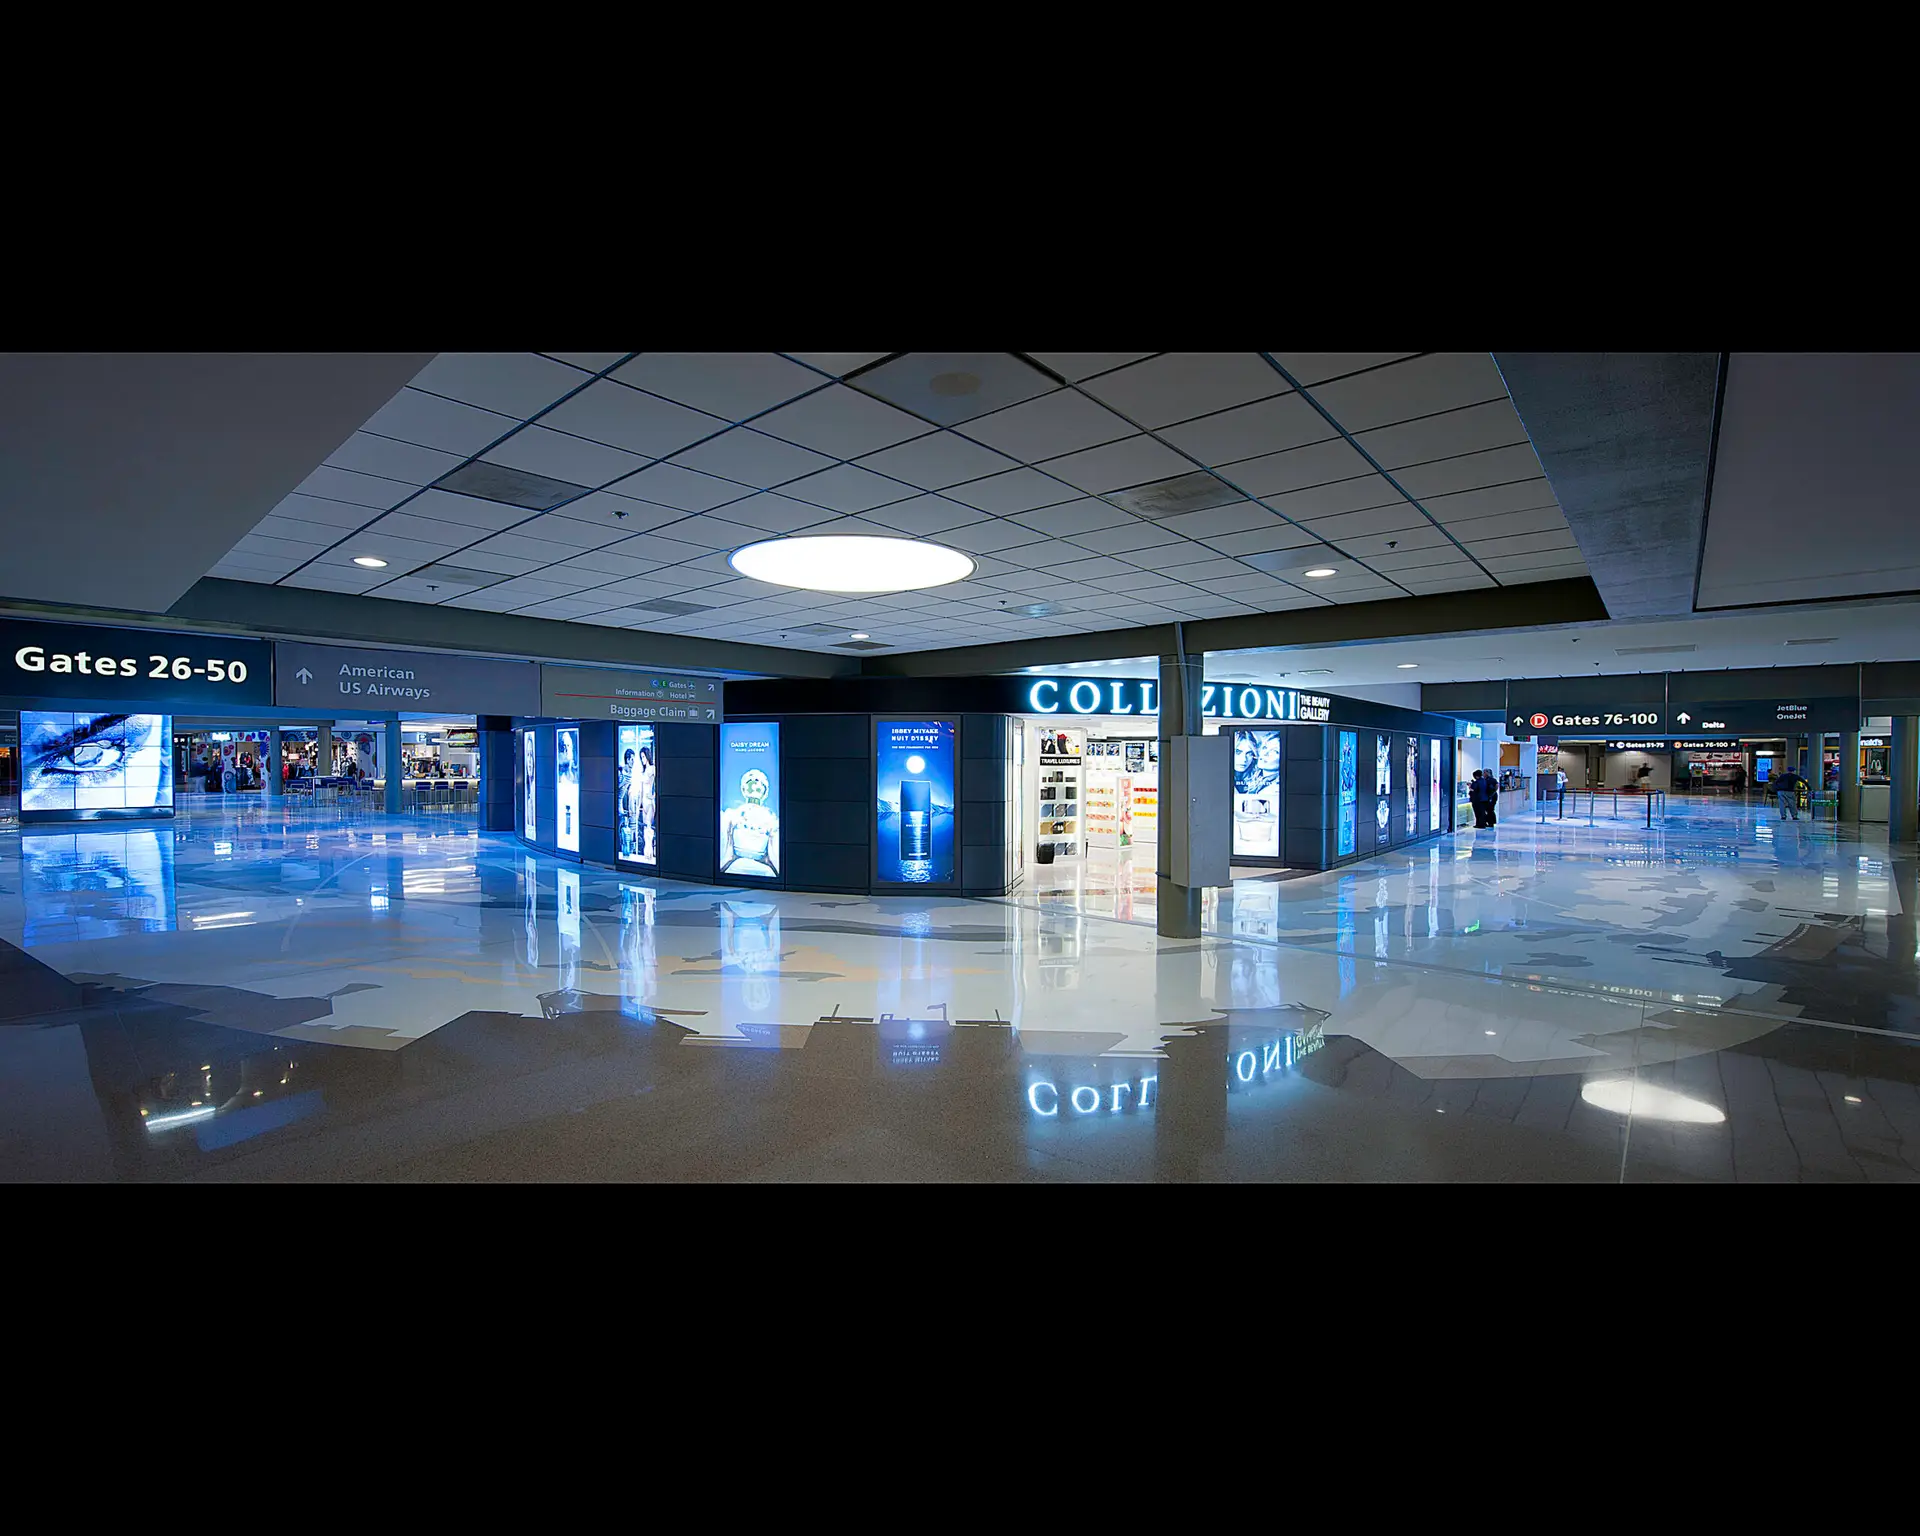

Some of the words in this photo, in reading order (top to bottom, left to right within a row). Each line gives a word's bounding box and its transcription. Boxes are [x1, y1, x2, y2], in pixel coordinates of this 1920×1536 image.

[15, 646, 138, 677] Gates
[148, 655, 248, 683] 26-50
[339, 663, 415, 680] American
[340, 681, 362, 694] US
[366, 683, 430, 700] Airways
[669, 681, 687, 689] Gates
[615, 687, 655, 698] Information
[669, 691, 687, 700] Hotel
[1029, 680, 1297, 719] COLLZIONI
[1300, 694, 1312, 706] THE
[1312, 696, 1331, 708] BEAUTY
[1776, 704, 1807, 712] JetBlue
[610, 704, 656, 719] Baggage
[659, 706, 687, 718] Claim
[1300, 706, 1330, 721] GALLERY
[1552, 714, 1600, 726] Gates
[1604, 712, 1658, 725] 76-100
[1702, 721, 1726, 729] Delta
[1625, 741, 1646, 749] Gates
